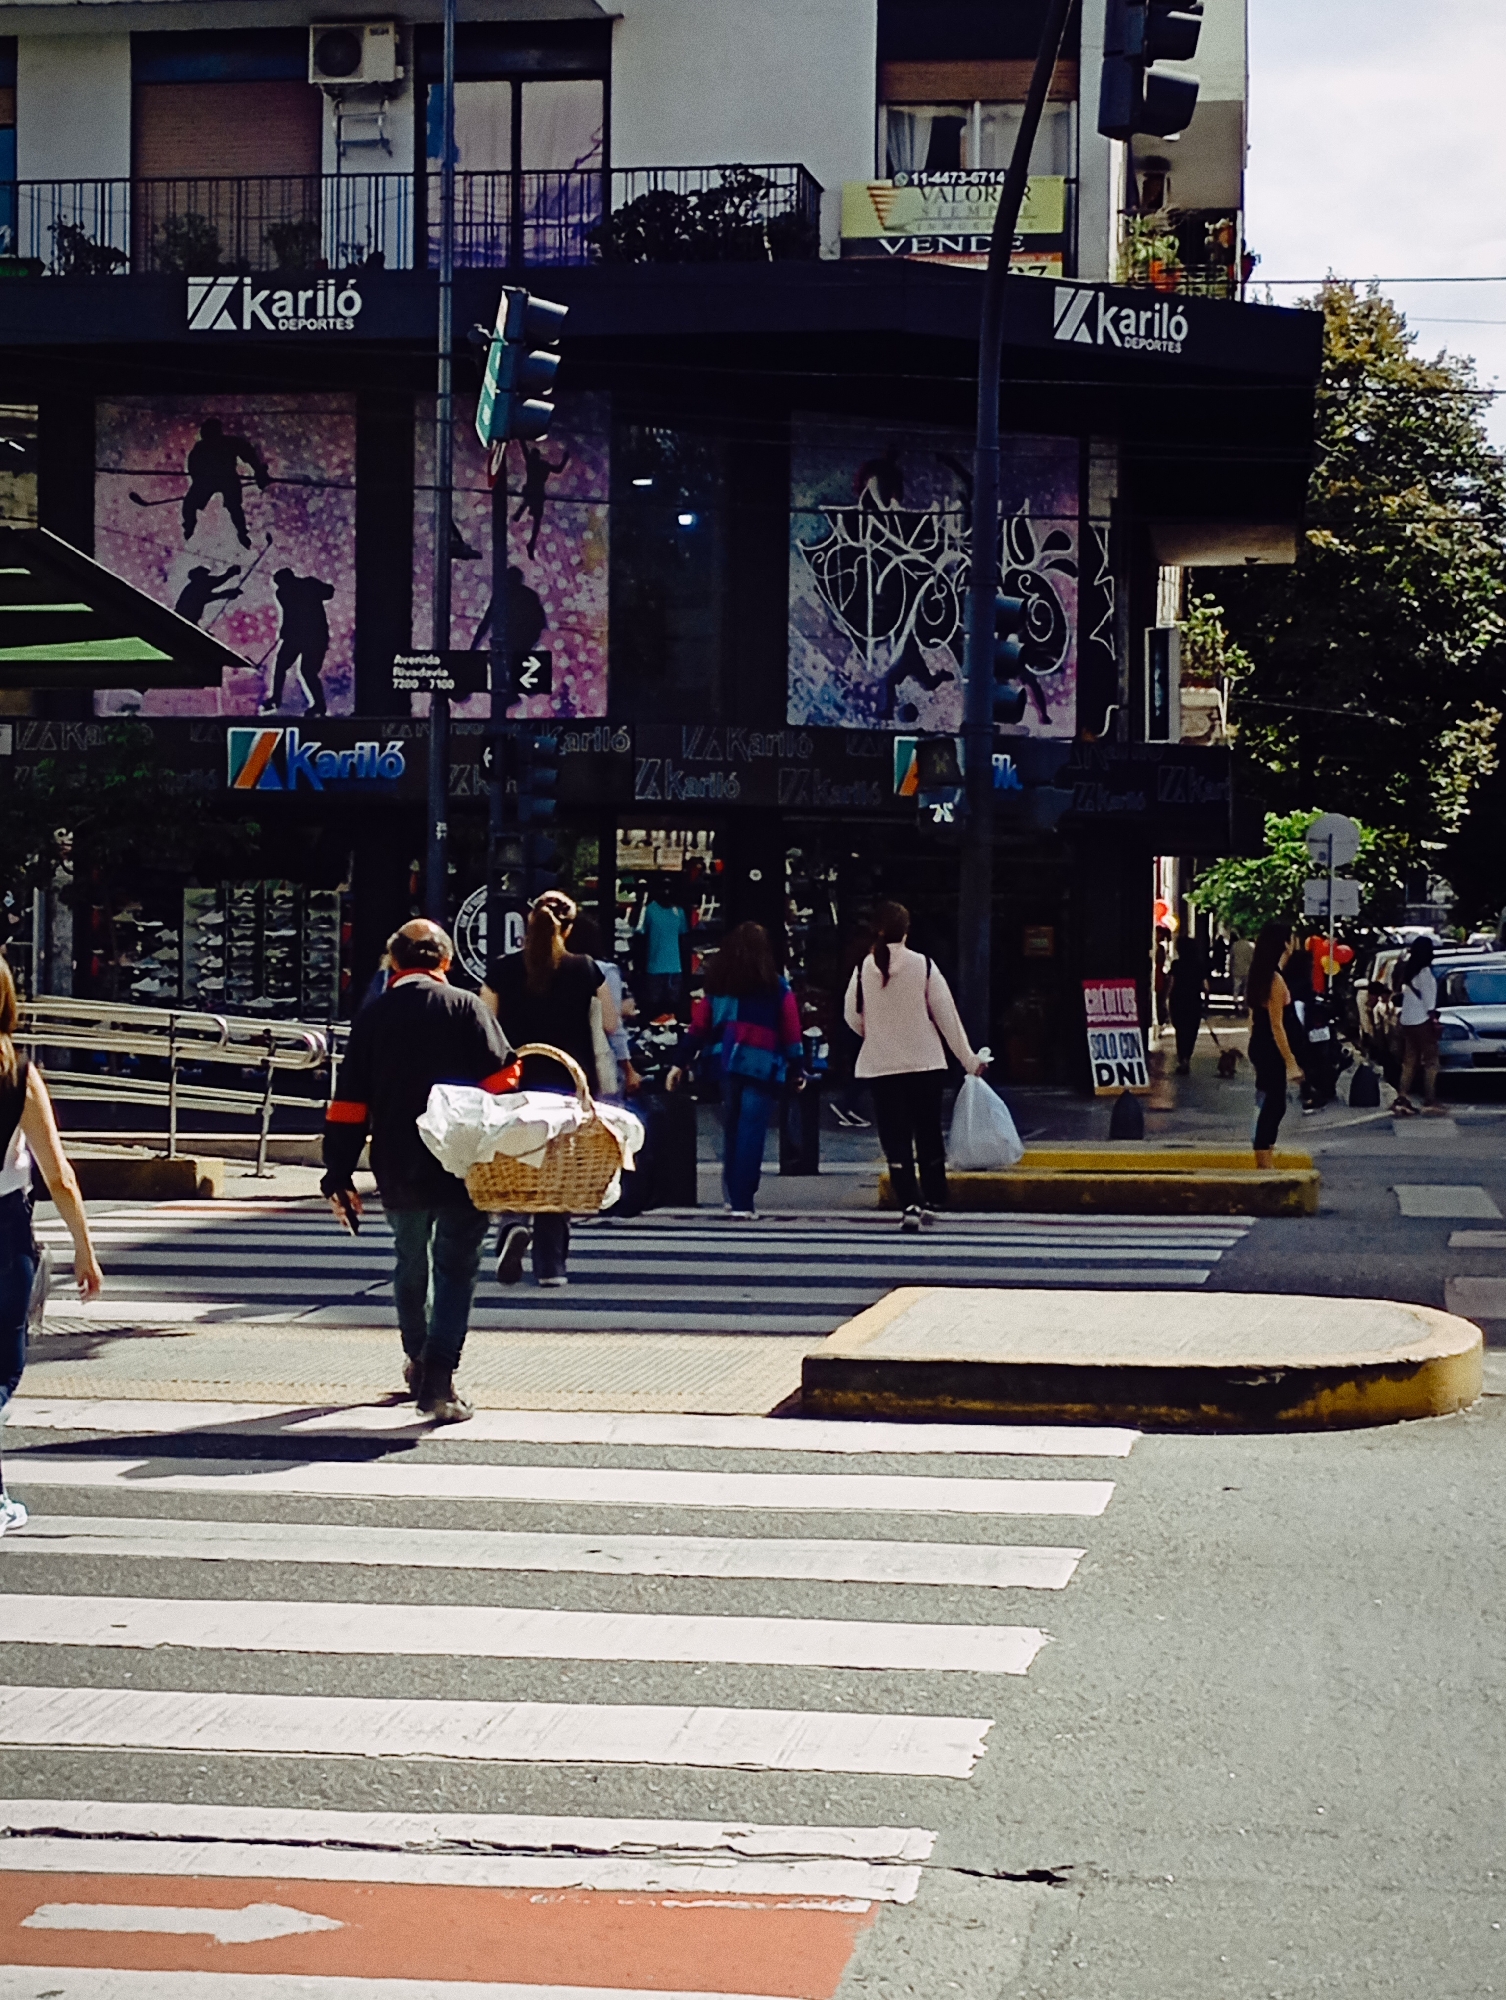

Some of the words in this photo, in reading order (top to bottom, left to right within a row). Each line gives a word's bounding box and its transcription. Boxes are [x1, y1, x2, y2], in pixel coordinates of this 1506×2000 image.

[917, 185, 1031, 203] VALORR
[278, 318, 354, 331] DEPORTES
[1123, 336, 1182, 354] DEPORTES
[393, 654, 441, 665] Avenida
[1095, 1062, 1146, 1087] DNI
